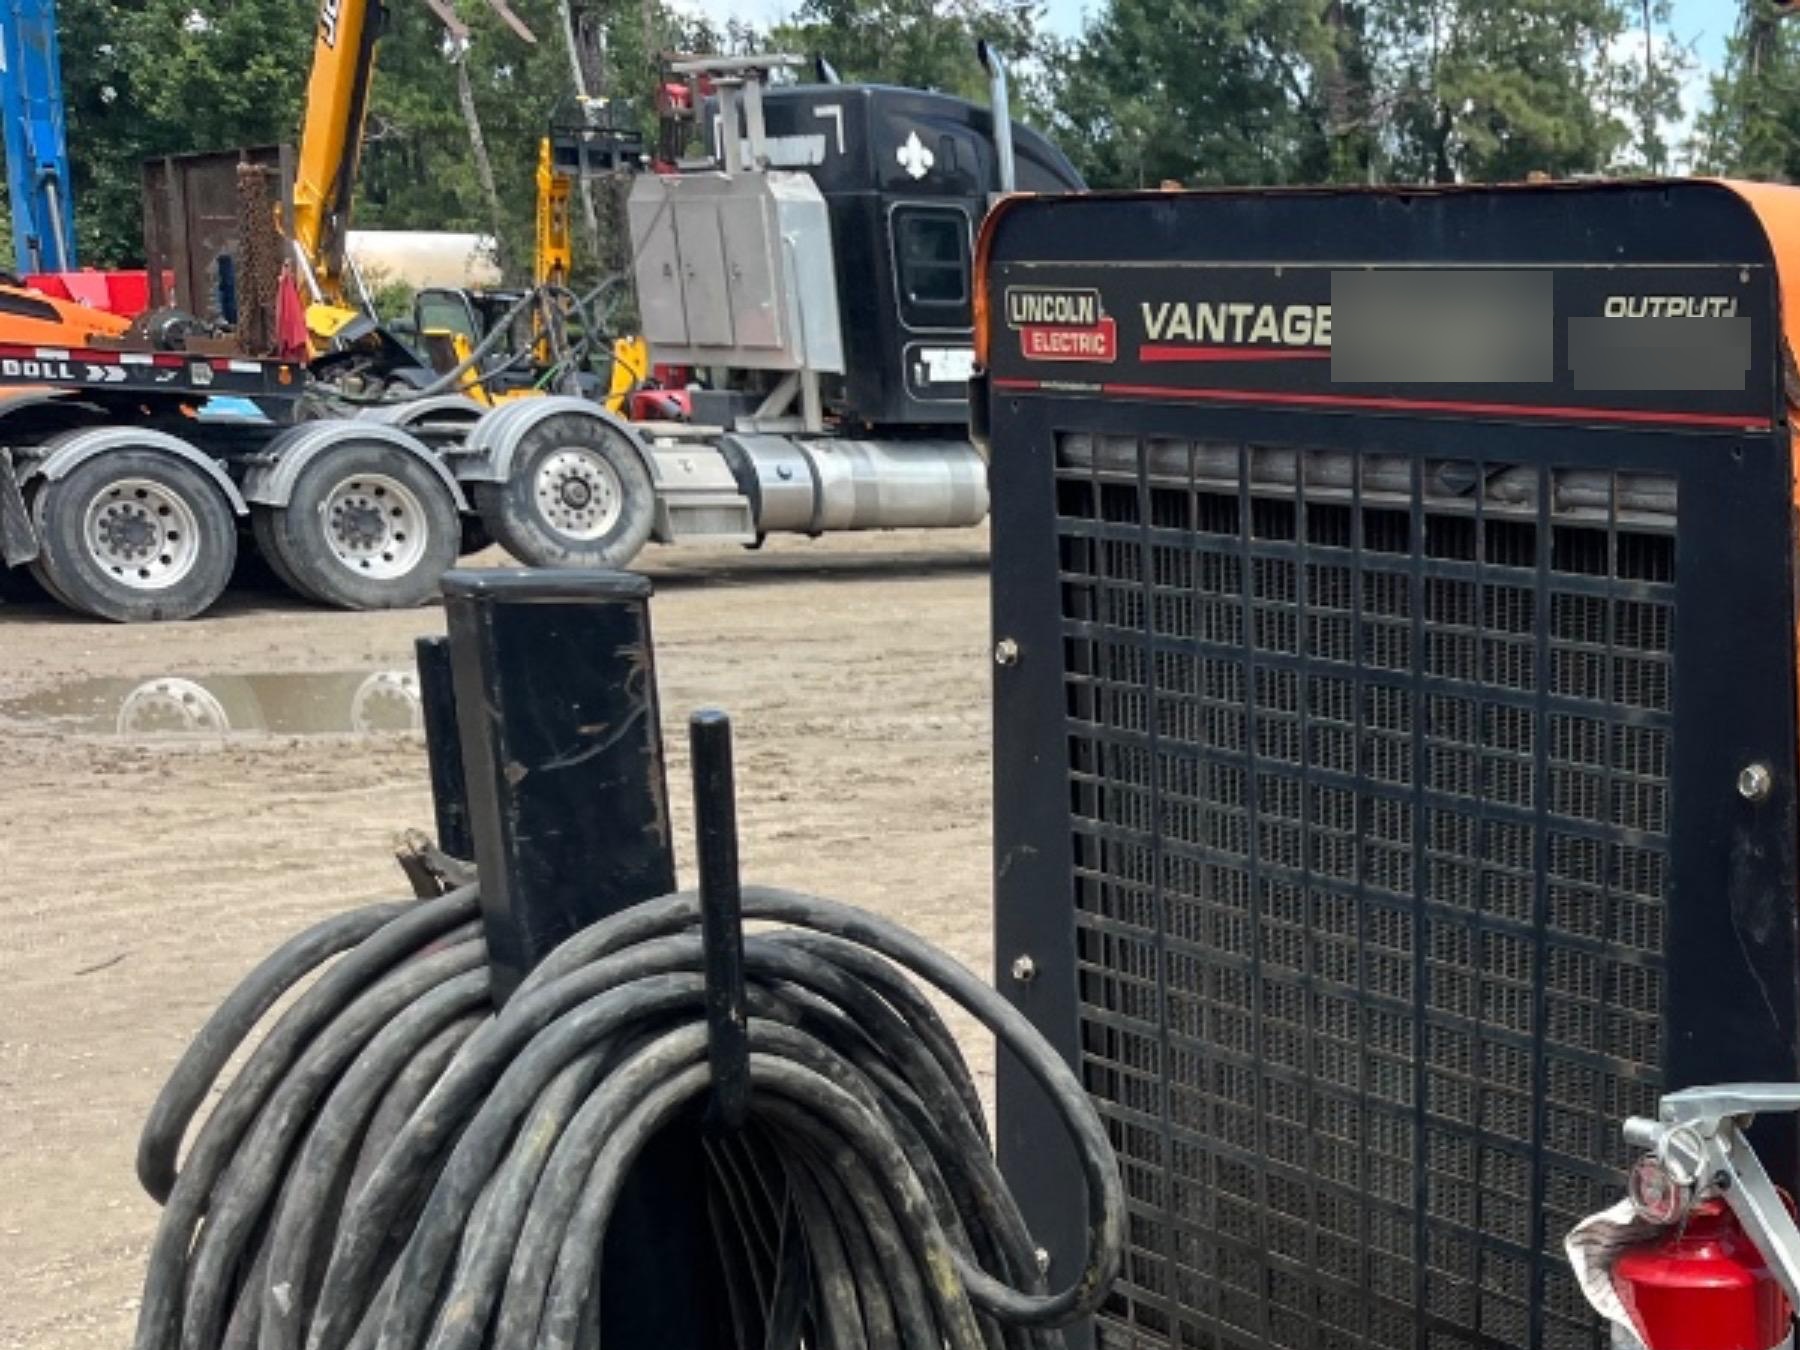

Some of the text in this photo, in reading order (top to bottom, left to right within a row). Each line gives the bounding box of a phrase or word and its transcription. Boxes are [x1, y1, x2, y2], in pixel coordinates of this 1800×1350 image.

[1010, 293, 1094, 323] LINCOLN
[1141, 302, 1331, 345] VANTAGE
[1031, 331, 1105, 355] ELECTRIC
